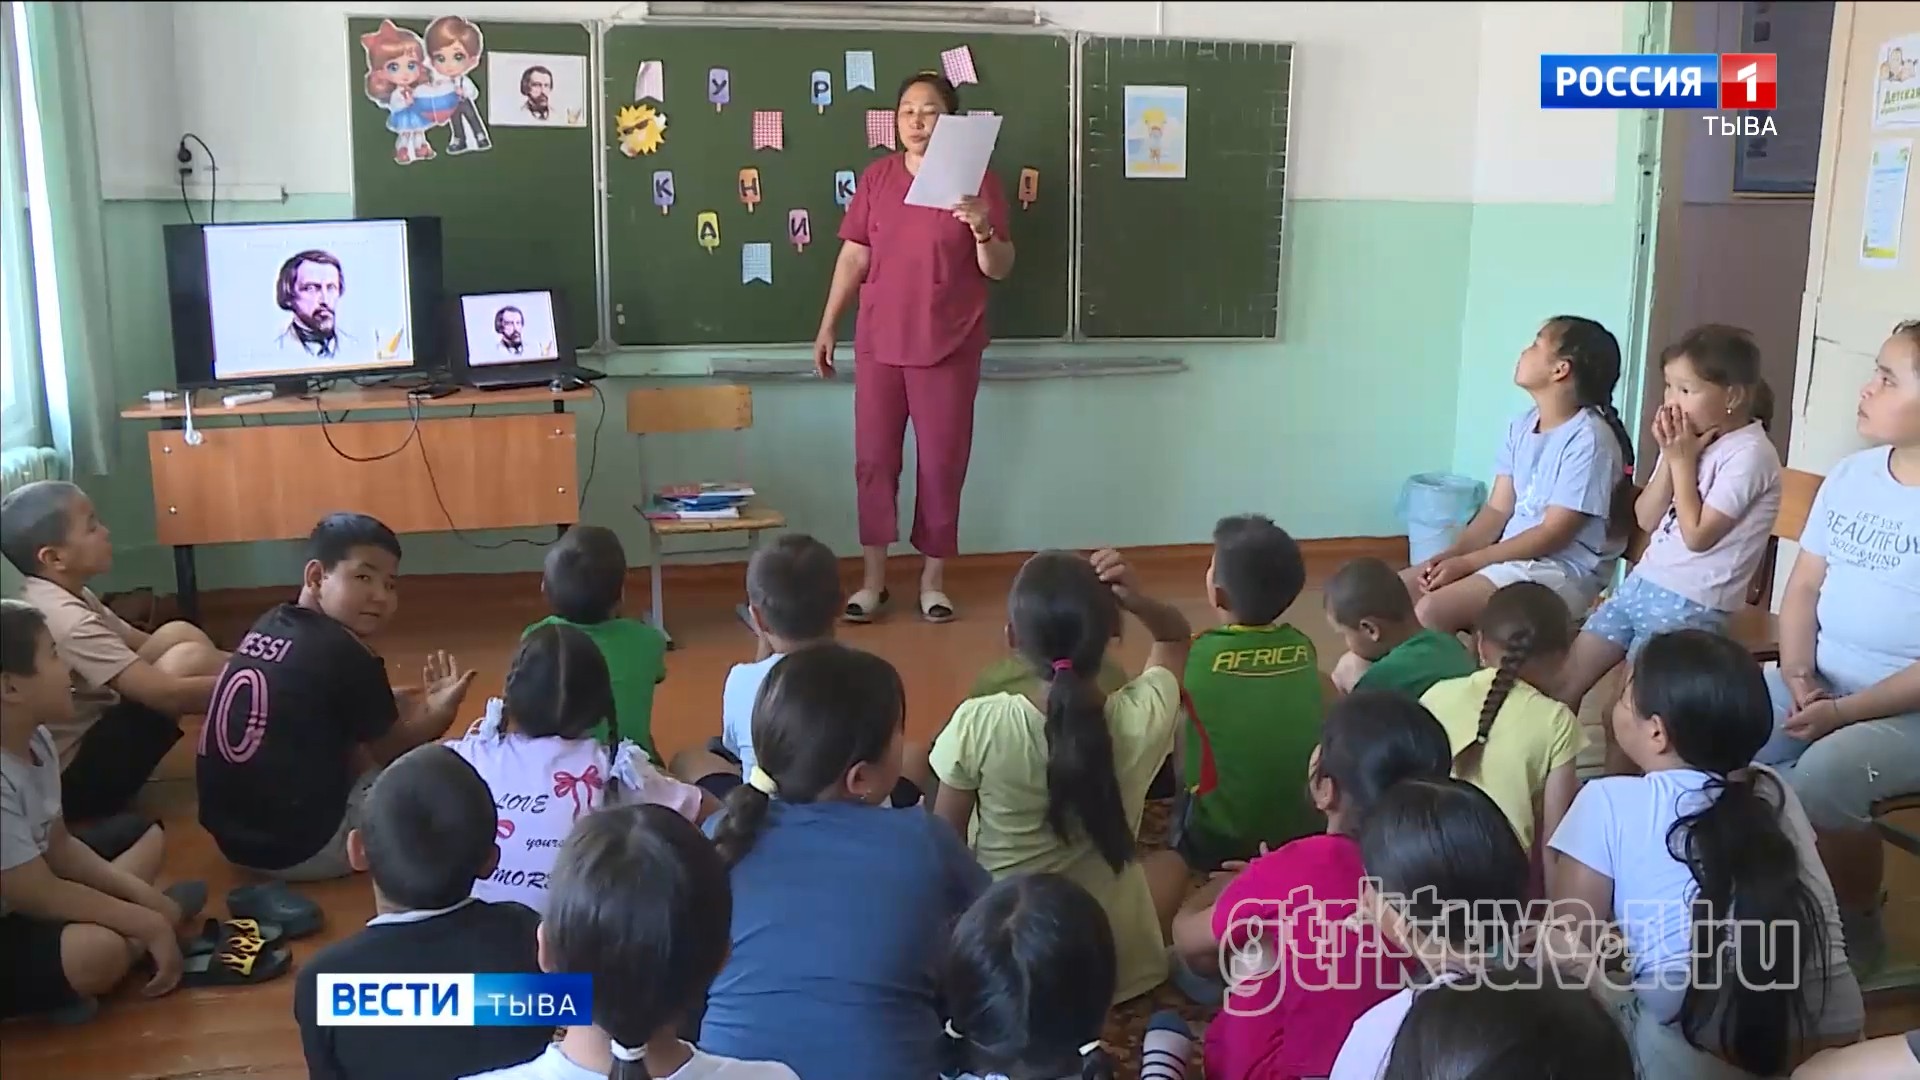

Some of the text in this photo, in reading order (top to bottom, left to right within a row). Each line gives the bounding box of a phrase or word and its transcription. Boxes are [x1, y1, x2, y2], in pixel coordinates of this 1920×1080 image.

[712, 77, 829, 99] У Р
[237, 631, 292, 662] ESSI
[1212, 645, 1309, 672] AFRICA
[496, 793, 549, 814] LOVE
